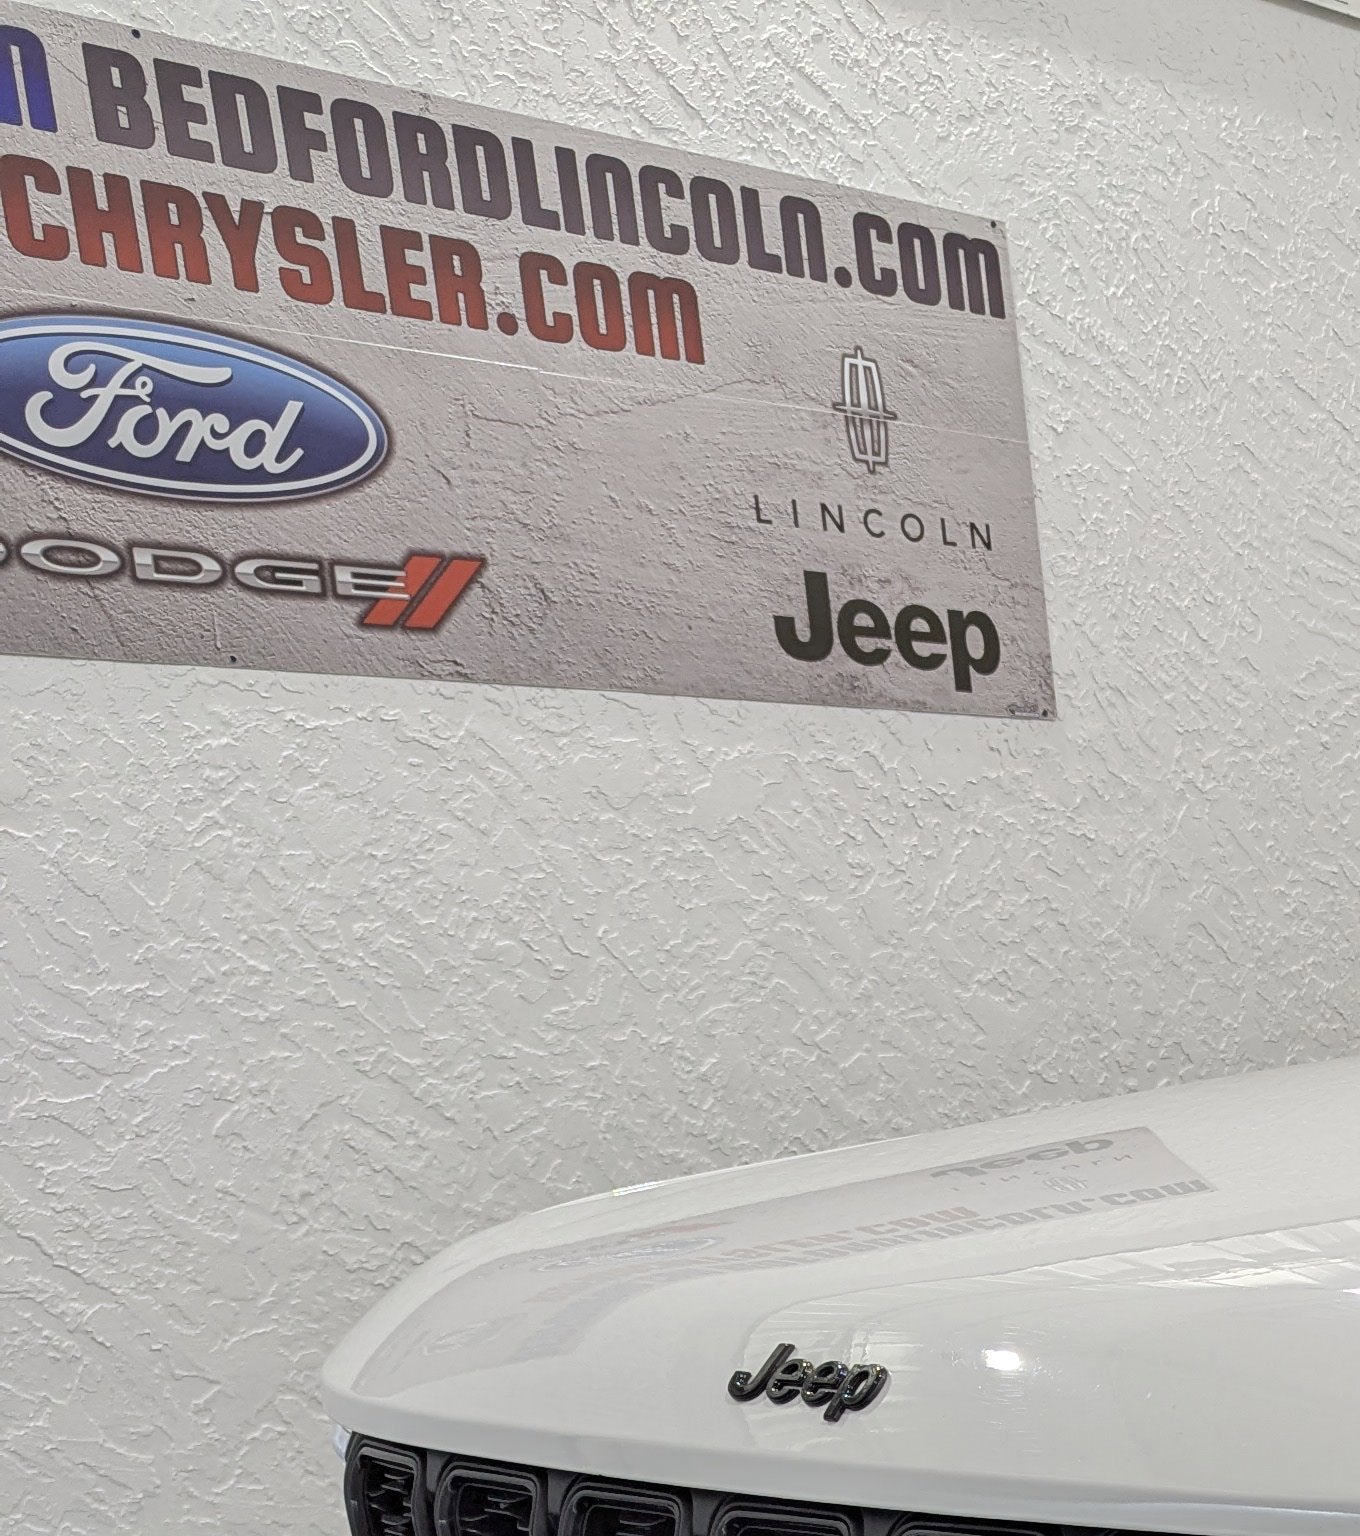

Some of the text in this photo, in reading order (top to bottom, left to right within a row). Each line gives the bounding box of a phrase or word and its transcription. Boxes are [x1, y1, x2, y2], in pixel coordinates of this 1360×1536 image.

[24, 341, 304, 475] Ford
[753, 494, 993, 551] LINCOLN
[0, 538, 411, 600] ODGE
[773, 569, 1001, 694] Jeep
[727, 1343, 889, 1423] Jeep
